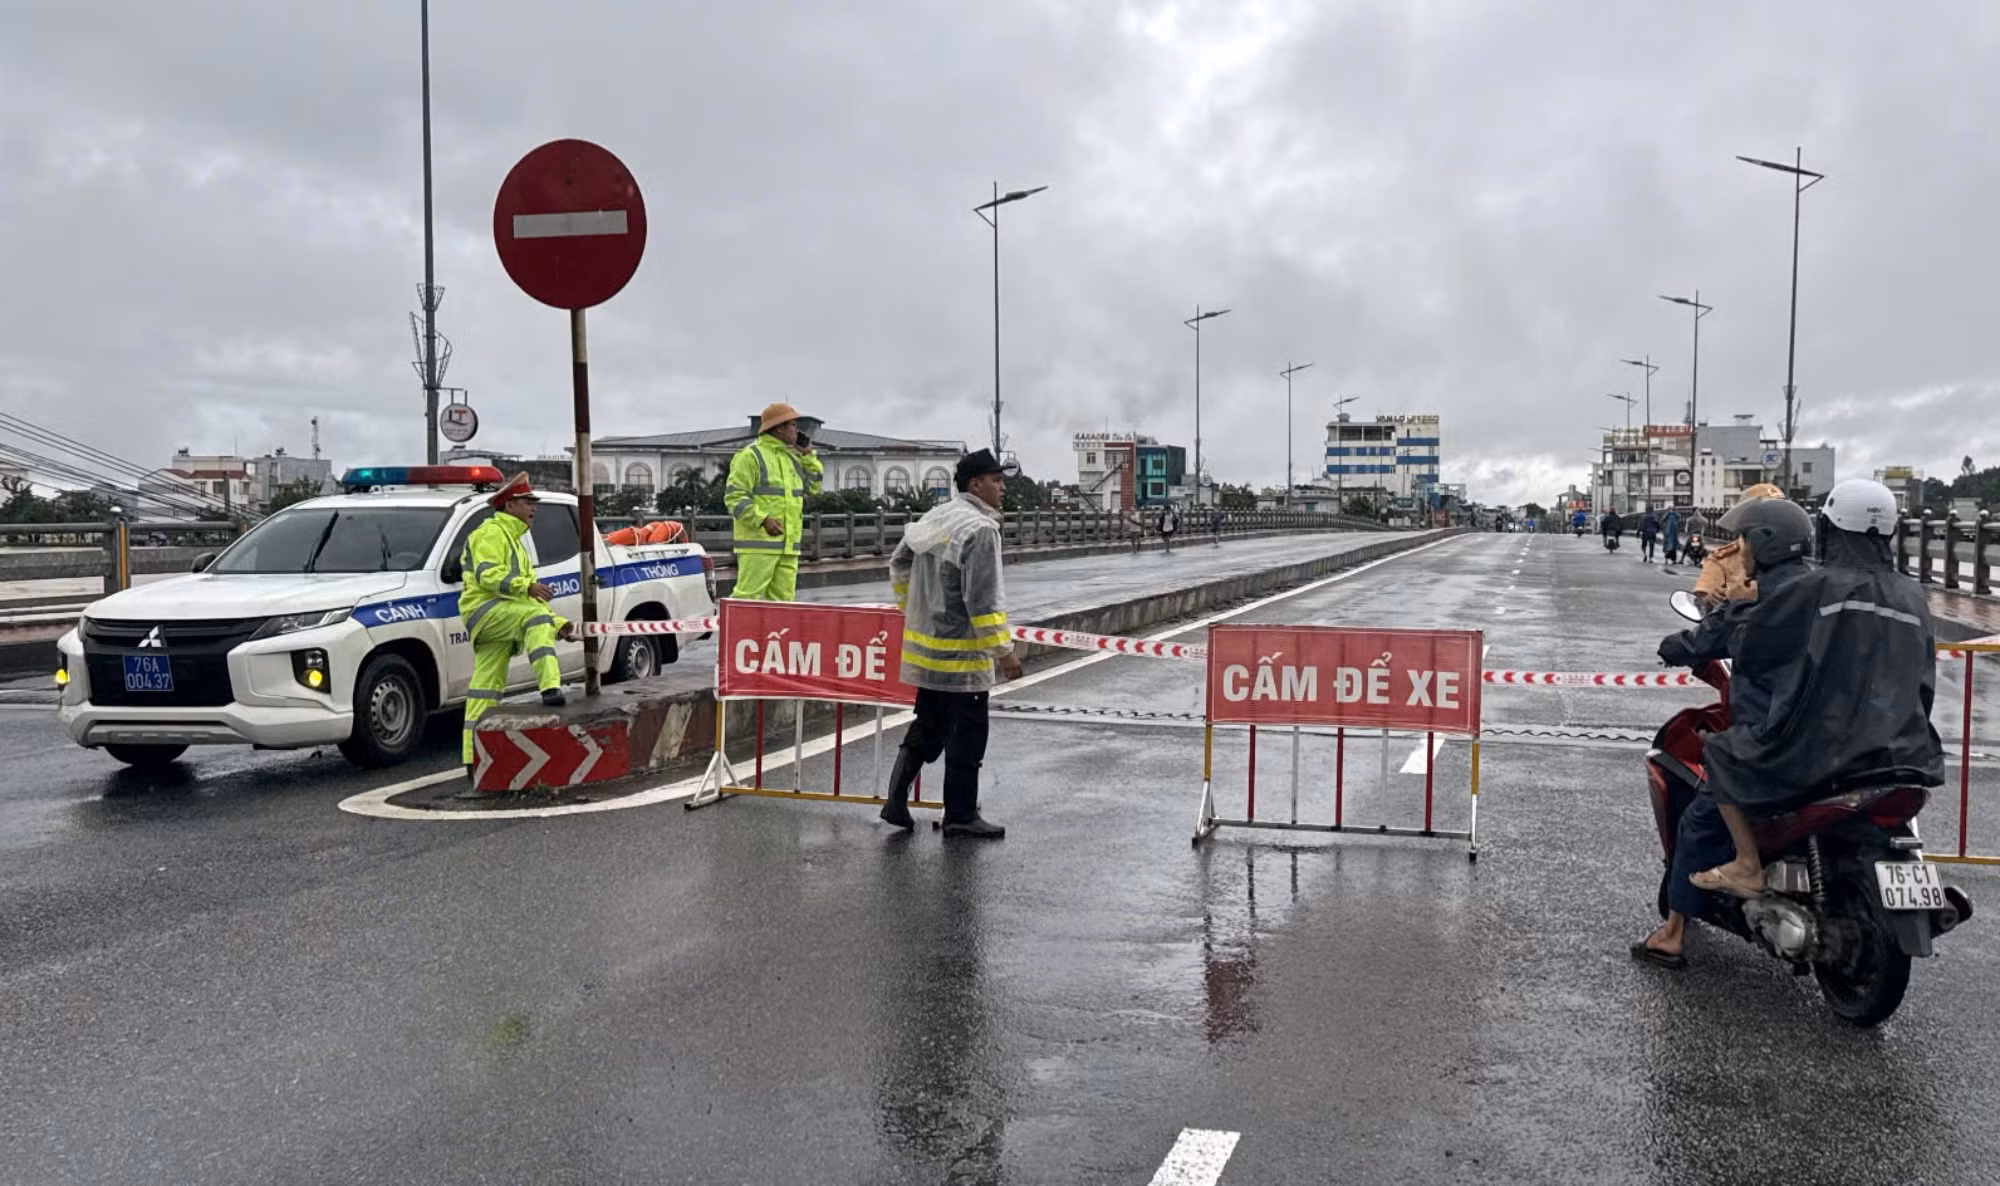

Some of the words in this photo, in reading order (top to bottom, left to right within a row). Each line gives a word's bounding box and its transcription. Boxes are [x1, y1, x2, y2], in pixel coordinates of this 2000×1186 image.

[375, 601, 427, 623] CẢNH
[548, 578, 580, 596] GIAO
[641, 562, 679, 579] THÔNG
[134, 656, 160, 672] 76A
[735, 627, 822, 677] CẤM
[834, 630, 889, 681] ĐỂ
[127, 673, 170, 689] 004.37
[1222, 651, 1318, 702] CẤM
[1332, 651, 1393, 705] ĐỂ
[1405, 669, 1460, 709] XE
[1885, 864, 1931, 885] 76-C1
[1885, 886, 1942, 907] 074.98
